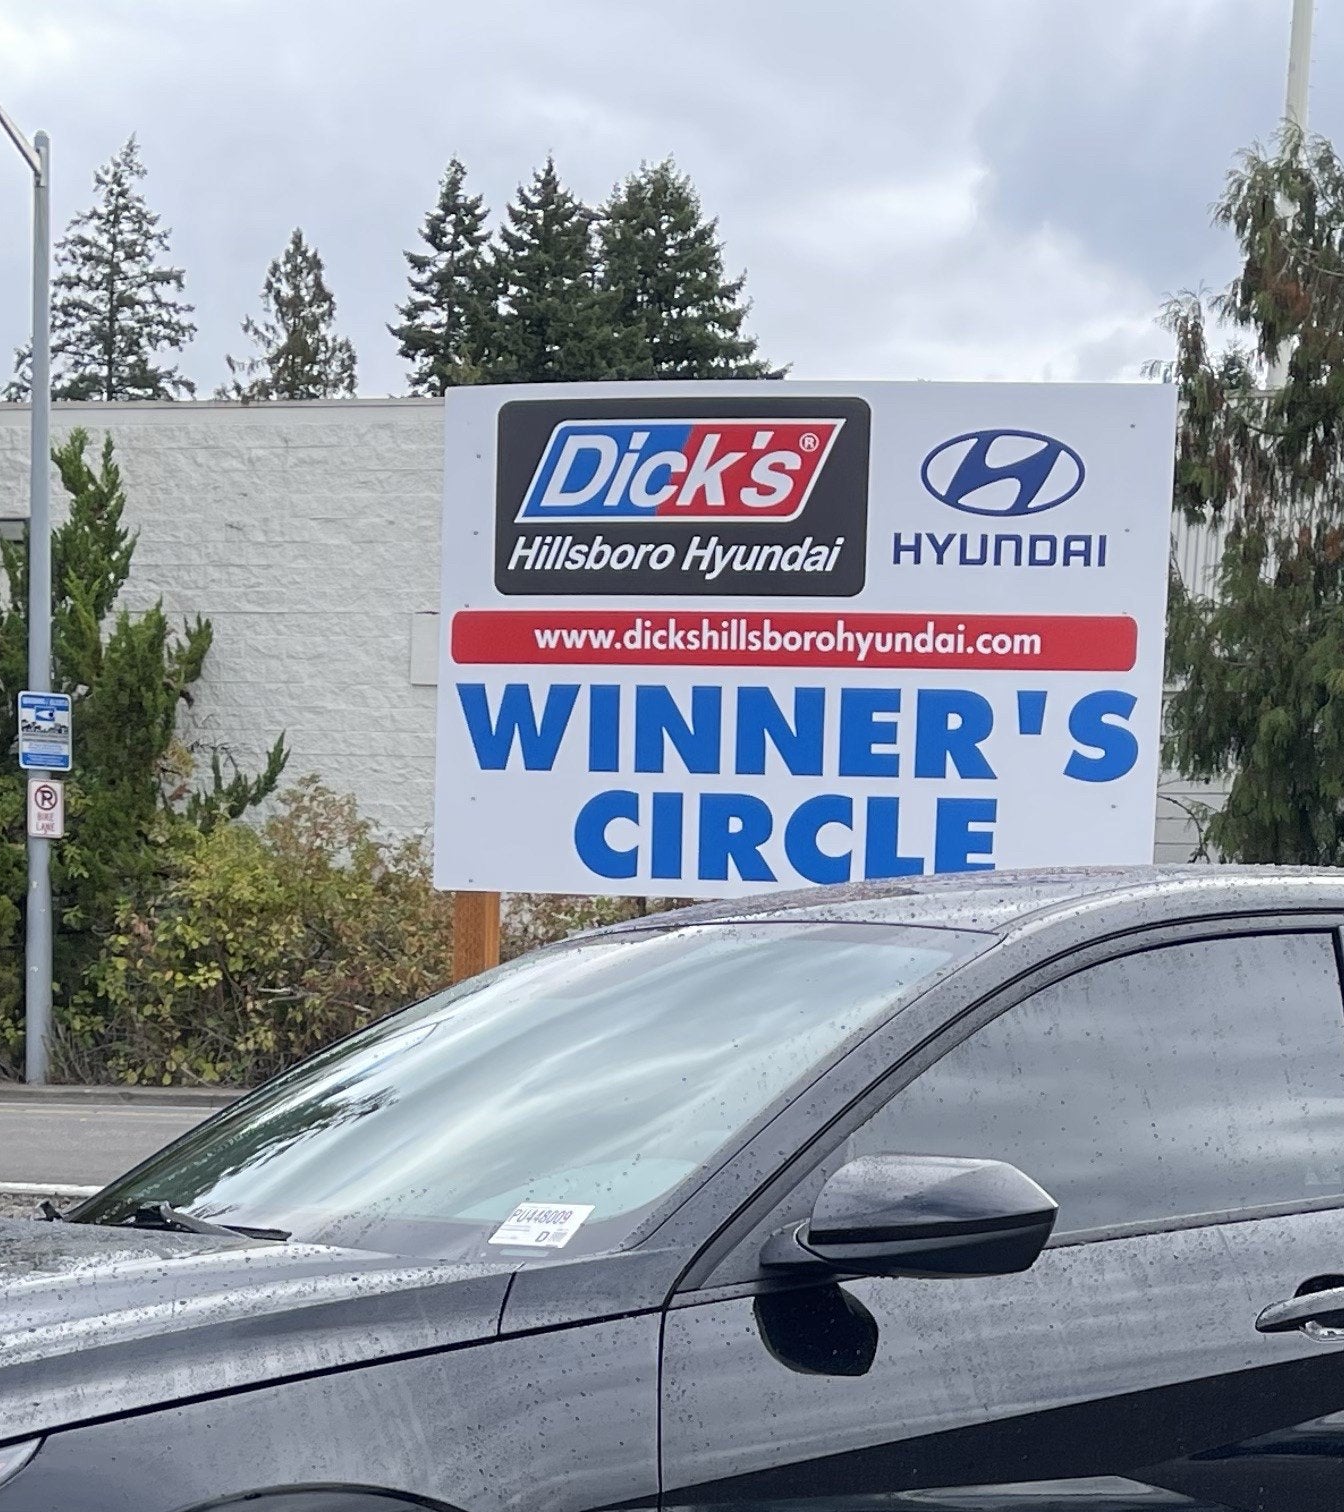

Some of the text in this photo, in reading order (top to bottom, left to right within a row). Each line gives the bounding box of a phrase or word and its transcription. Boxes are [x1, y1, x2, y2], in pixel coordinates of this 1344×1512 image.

[540, 431, 802, 508] Dick's
[507, 536, 845, 580] Hillsboro Hyundai
[892, 533, 1106, 567] HYUNDAI
[534, 618, 1042, 659] www.dickshillsborohyundai.com
[456, 682, 1139, 783] WINNER'S
[572, 789, 998, 884] CIRCLE
